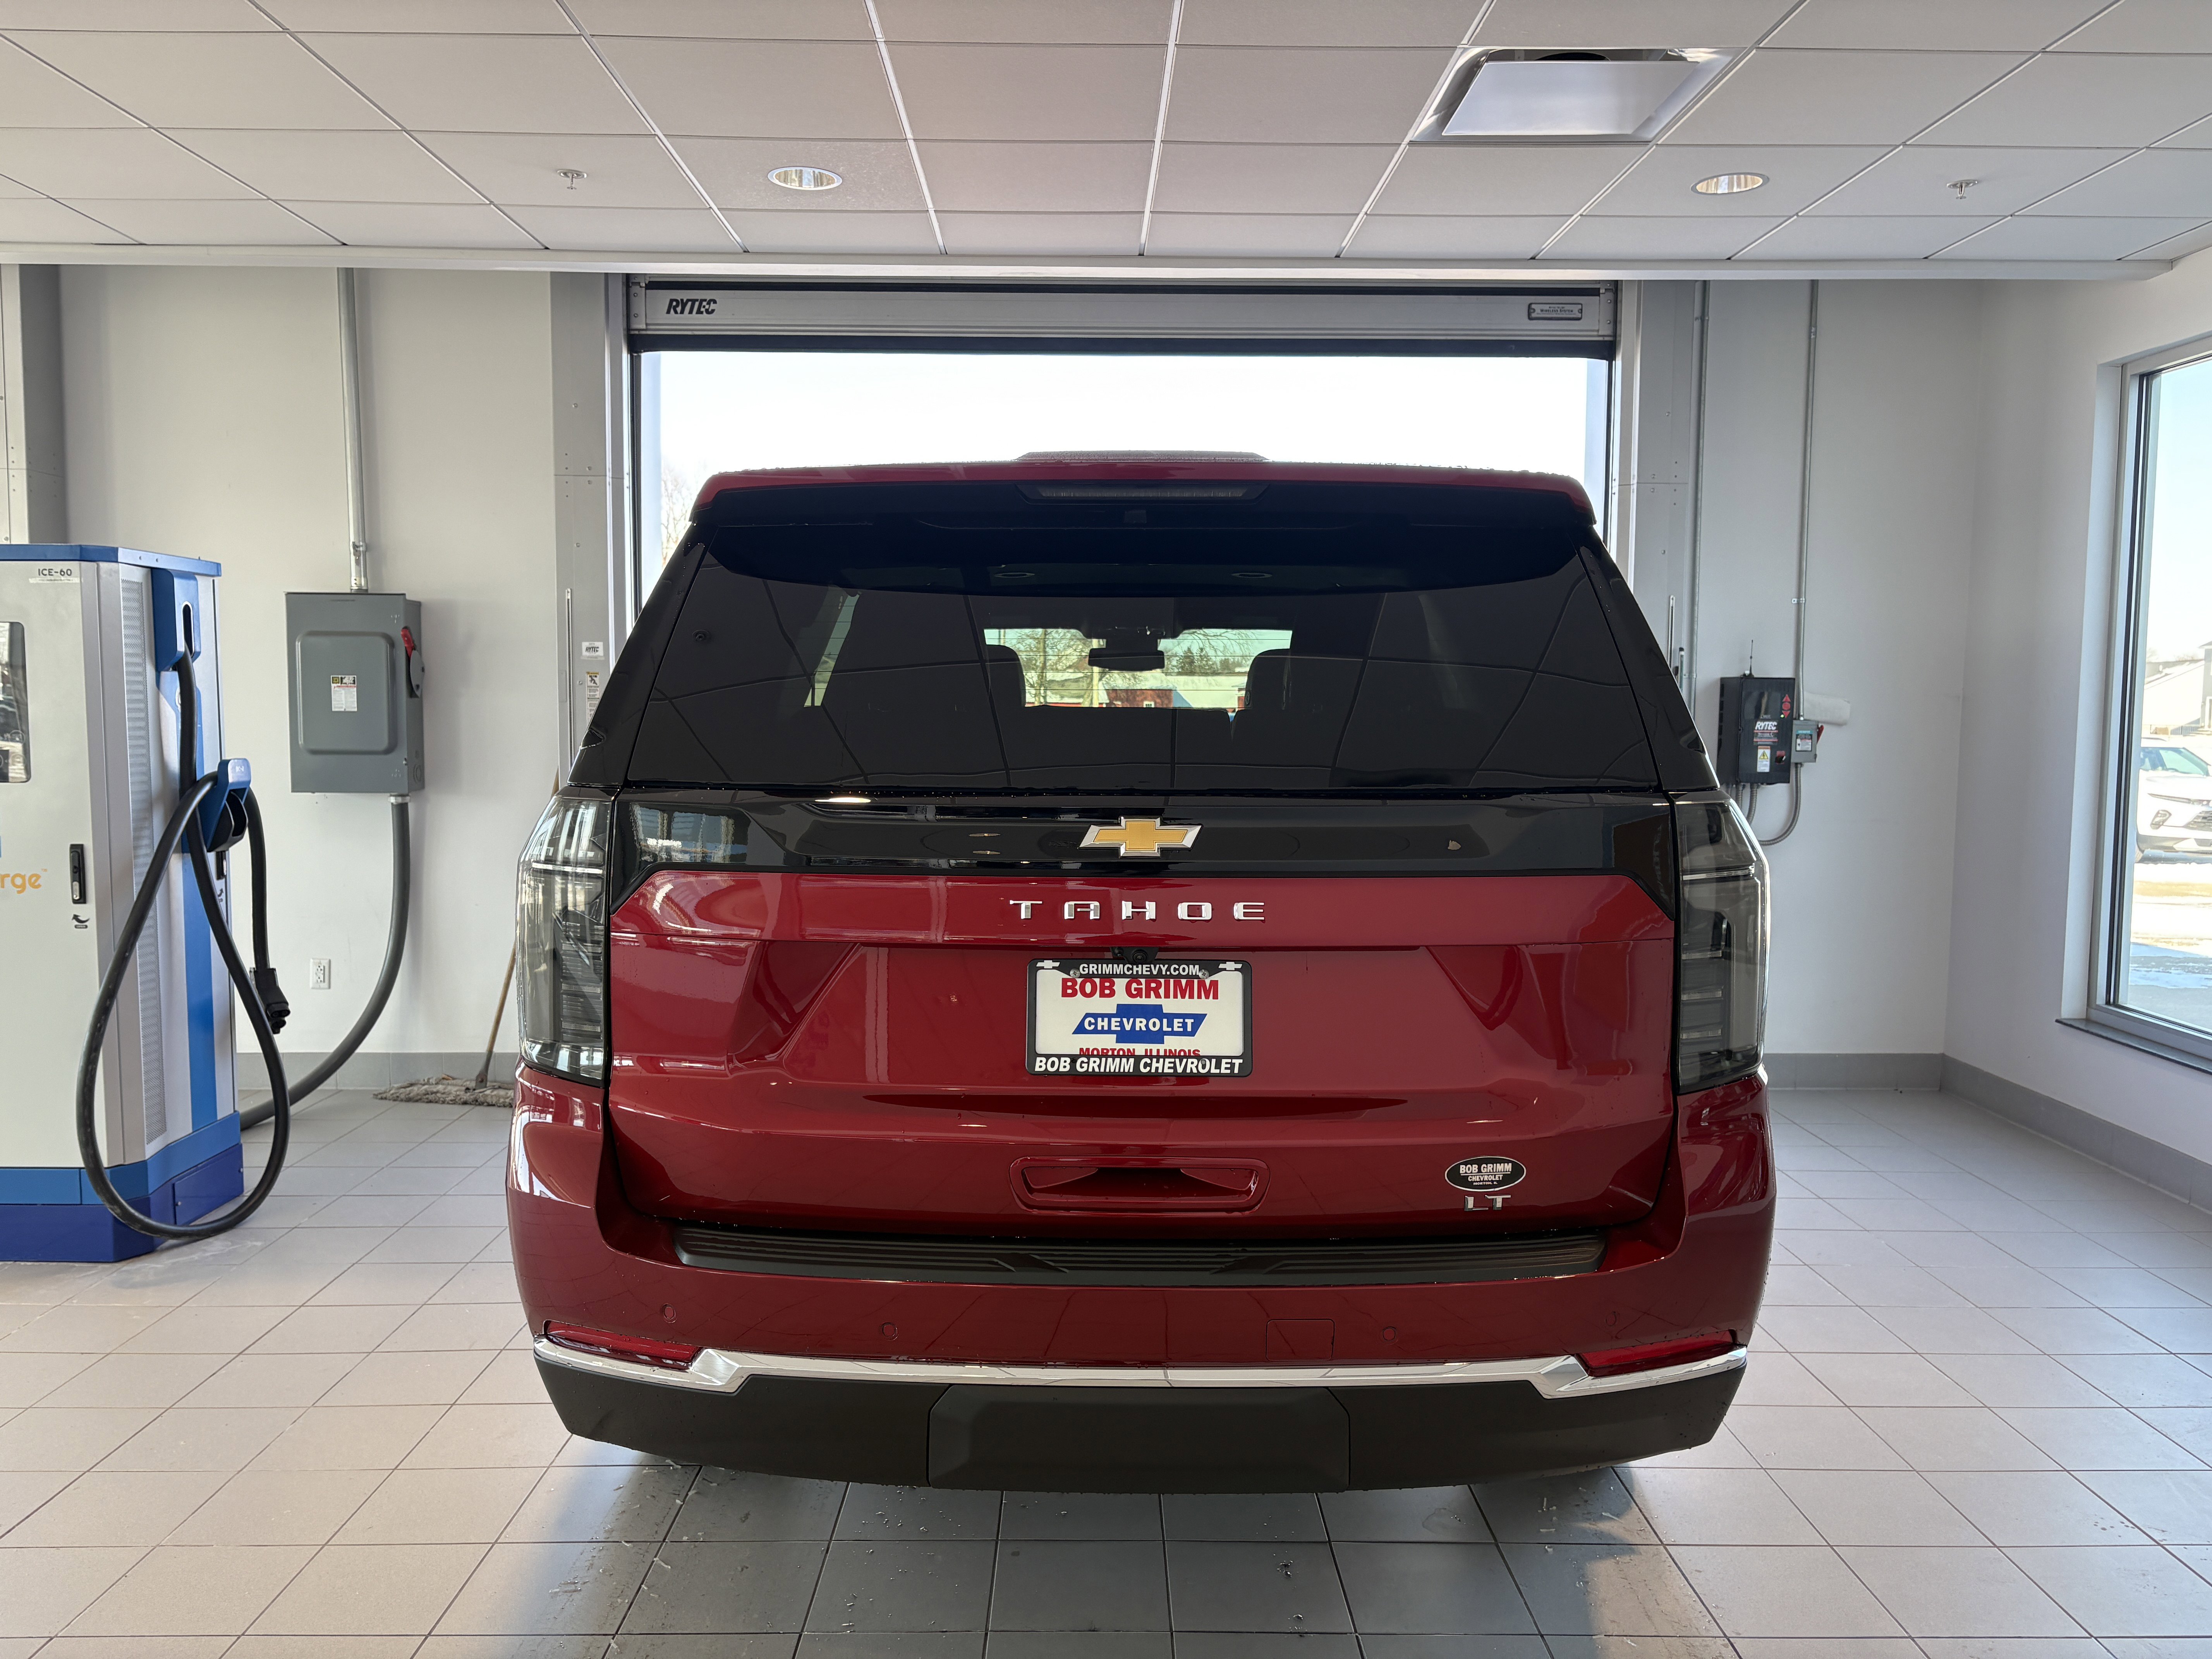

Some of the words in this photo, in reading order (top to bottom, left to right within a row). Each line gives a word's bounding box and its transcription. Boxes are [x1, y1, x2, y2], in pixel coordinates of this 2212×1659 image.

[666, 299, 717, 314] RYTEC
[38, 568, 72, 576] ICE-60
[1755, 721, 1778, 730] RYTEC
[1009, 900, 1265, 920] TAHOE
[1079, 963, 1199, 975] GRIMMCHEVY.COM
[1061, 978, 1116, 998] BOB
[1125, 979, 1219, 1000] GRIMM
[1084, 1017, 1194, 1032] CHEVROLET
[1035, 1057, 1070, 1072] BOB
[1076, 1058, 1134, 1073] GRIMM
[1140, 1058, 1243, 1073] CHEVROLET
[1460, 1164, 1478, 1174] BOB
[1481, 1163, 1512, 1173] GRIMM
[1465, 1194, 1511, 1211] LT
